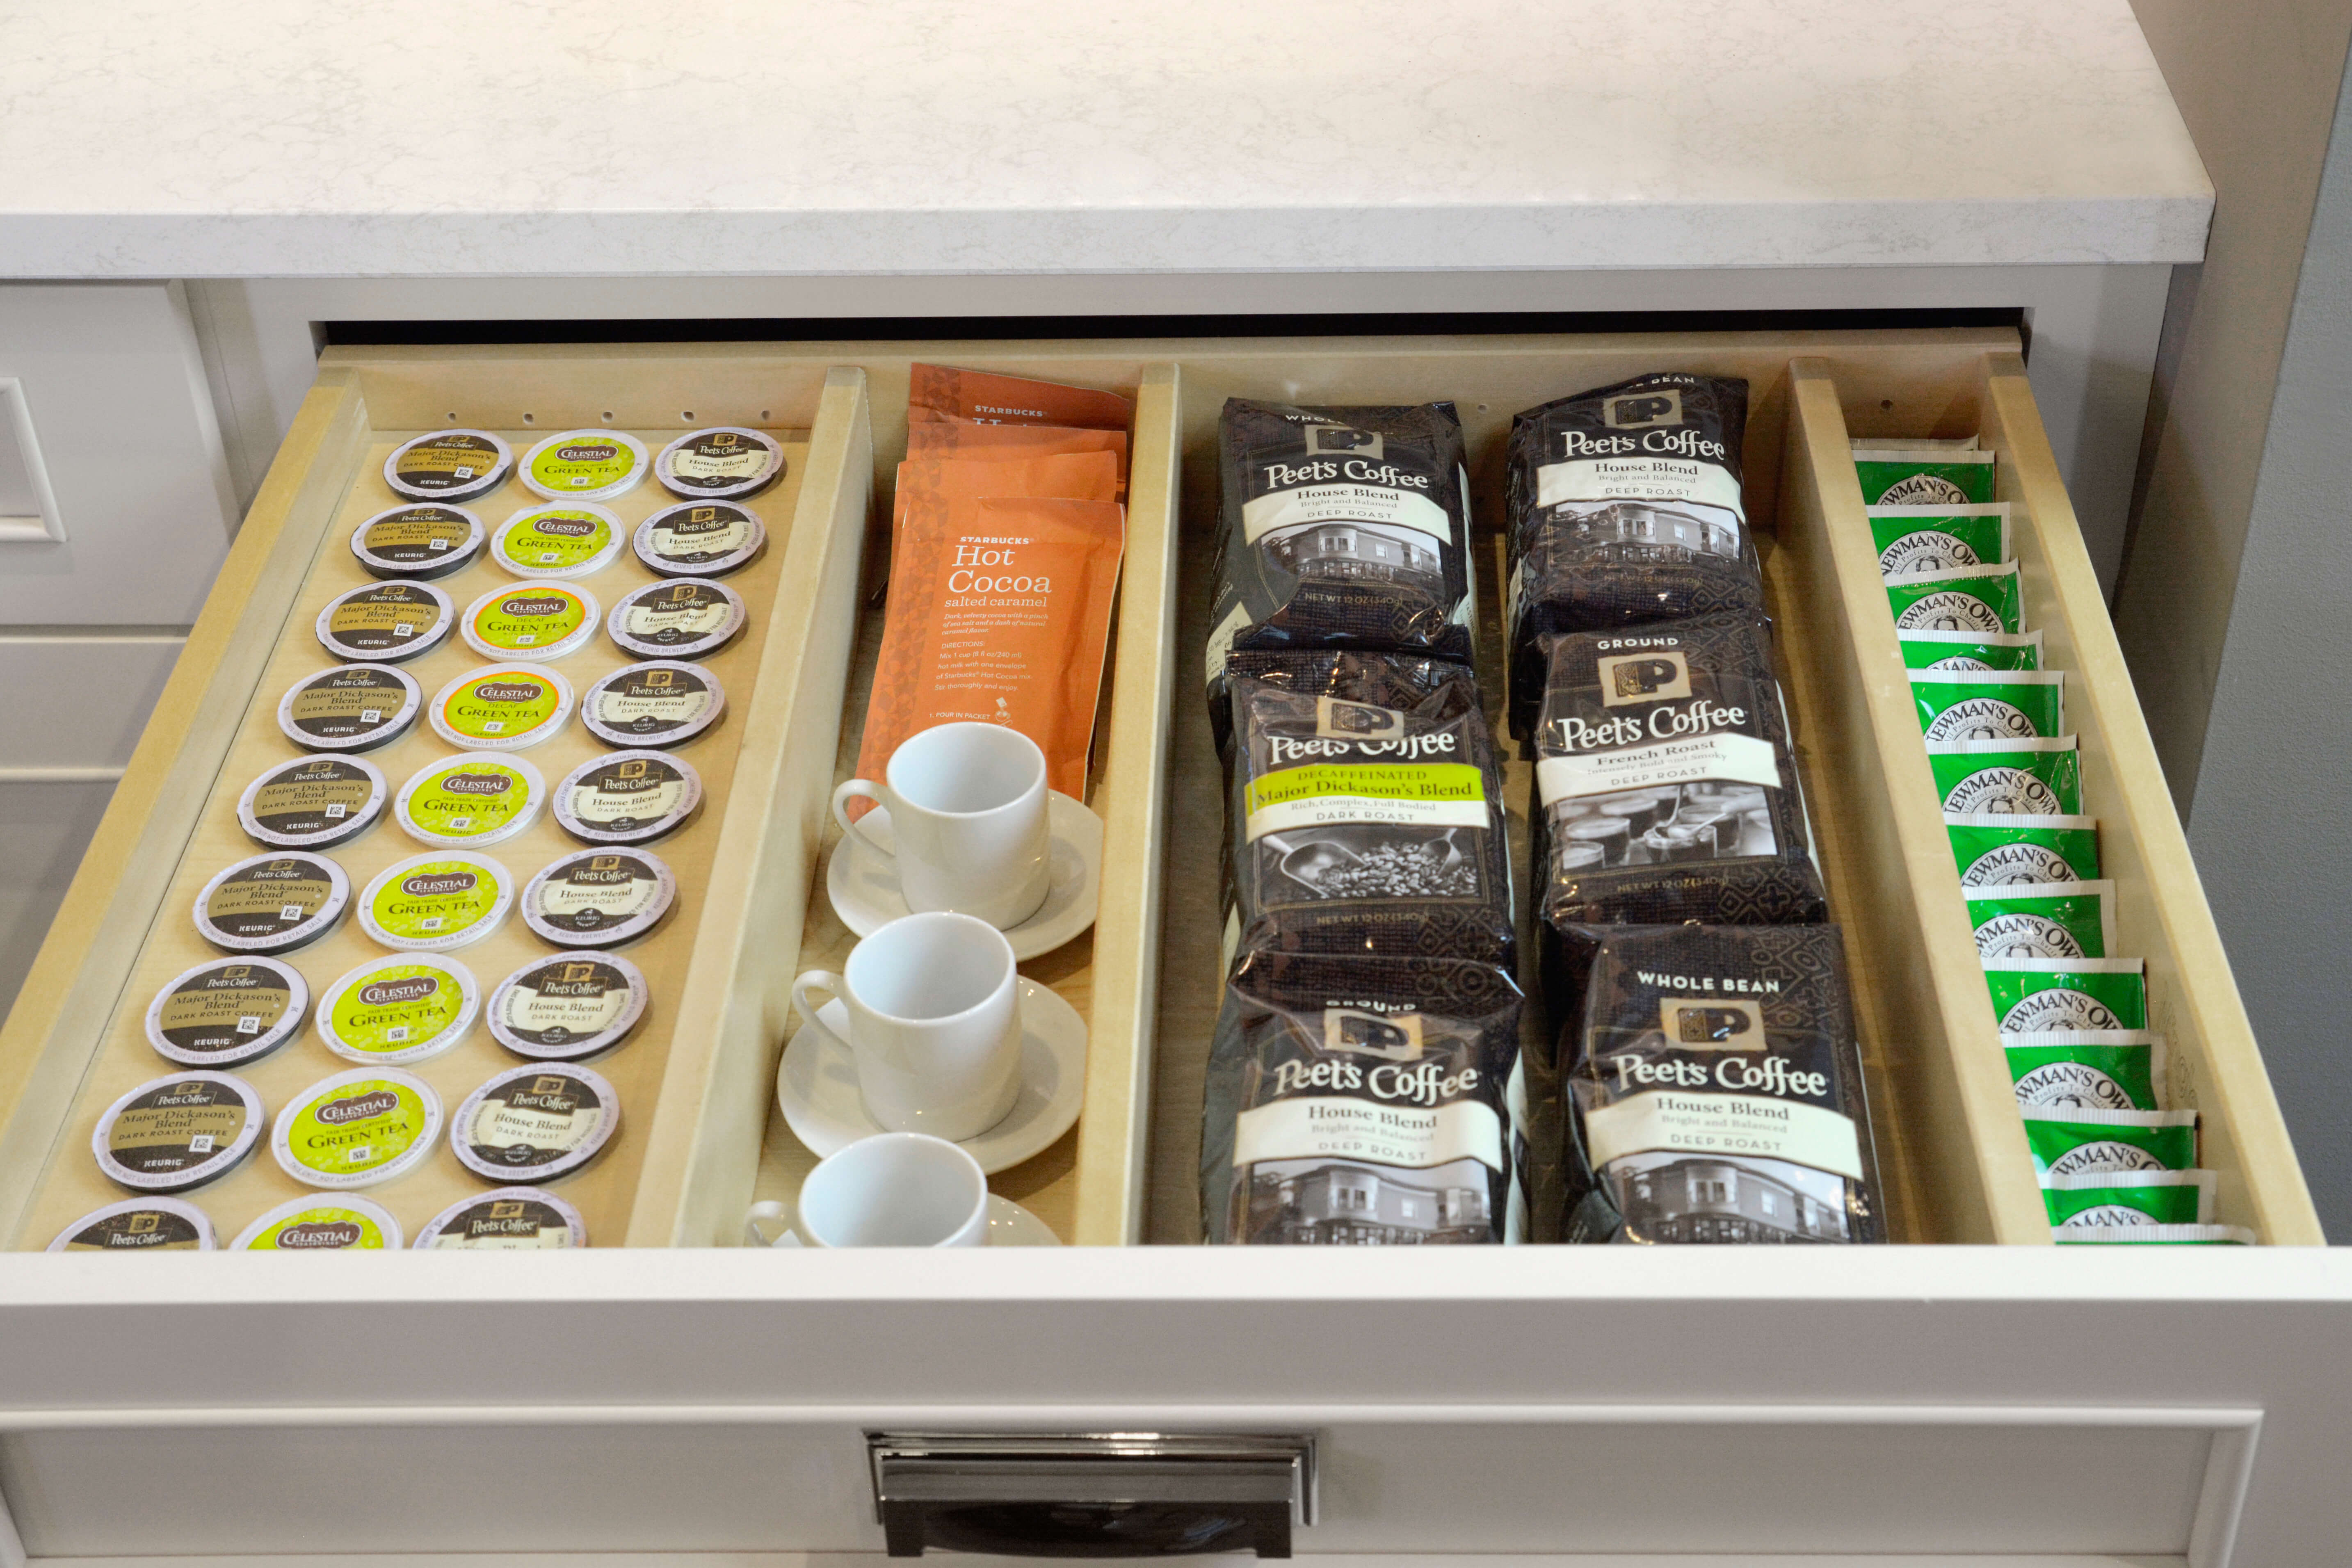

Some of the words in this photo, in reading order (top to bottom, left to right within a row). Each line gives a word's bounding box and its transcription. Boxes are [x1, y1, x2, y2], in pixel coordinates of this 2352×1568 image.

[975, 405, 1043, 417] STARBUCKS
[1286, 415, 1345, 424] WHOL
[1642, 429, 1724, 460] Coffee
[561, 449, 612, 459] CELESTIAL
[544, 465, 598, 474] GREEN
[602, 465, 620, 473] TEA
[1344, 460, 1428, 488] Coffee
[1595, 463, 1646, 473] House
[1652, 463, 1699, 475] Blend
[1297, 488, 1348, 500] House
[1354, 488, 1400, 501] Blend
[1647, 488, 1690, 497] ROAST
[1301, 499, 1329, 508] Bright
[1355, 499, 1397, 508] Balanced
[1349, 510, 1392, 519] ROAST
[952, 545, 1015, 566] Hot
[948, 570, 1052, 593] Cocoa
[507, 602, 561, 611] CELESTIAL
[945, 596, 986, 607] salted
[990, 597, 1047, 607] caramel
[341, 605, 371, 614] Major
[374, 605, 431, 614] Dickason's
[1898, 595, 1968, 630] EWMAN'S
[1918, 609, 1944, 624] Profits
[487, 621, 539, 631] GREEN
[396, 644, 417, 653] RETAIL
[417, 635, 431, 645] SALE
[1597, 637, 1678, 650] GROUND
[1648, 700, 1746, 738] Coffee
[1953, 719, 1980, 732] Profits
[1596, 749, 1658, 766] French
[1665, 739, 1717, 757] Roast
[1640, 759, 1664, 768] Bold
[1691, 751, 1728, 763] Smoky
[1297, 770, 1427, 781] DECAFFEINATED
[1611, 773, 1649, 786] DEEP
[1658, 767, 1706, 779] ROAST
[630, 778, 660, 789] Coffee
[265, 787, 298, 796] Major
[1257, 785, 1310, 805] Major
[1316, 781, 1414, 796] Dickason's
[1420, 782, 1472, 796] Blend
[1972, 787, 2000, 803] Profits
[592, 798, 629, 806] House
[632, 793, 662, 805] Blend
[1291, 801, 1316, 811] Rich,
[1319, 799, 1372, 808] Complex,
[1398, 802, 1436, 811] Bodied
[625, 803, 654, 812] ROAST
[1317, 812, 1356, 821] DARK
[1365, 812, 1415, 821] ROAST
[408, 879, 470, 891] CELESTIAL
[388, 903, 446, 914] GREEN
[452, 901, 480, 910] TEA
[1637, 972, 1715, 991] WHOLE
[1723, 979, 1780, 993] BEAN
[529, 1002, 566, 1011] House
[569, 1003, 604, 1012] Blend
[2000, 993, 2088, 1034] EWMAN'S
[1715, 1056, 1827, 1096] Coffee
[1368, 1063, 1478, 1105] Coffee
[322, 1098, 391, 1120] CELESTIAL
[1658, 1098, 1723, 1114] House
[1731, 1102, 1790, 1120] Blend
[1309, 1105, 1373, 1120] House
[1380, 1114, 1438, 1128] Blend
[307, 1129, 371, 1148] GREEN
[377, 1122, 409, 1135] TEA
[1671, 1134, 1715, 1145] DEEP
[1724, 1137, 1782, 1151] ROAST
[284, 1231, 352, 1244] CELESTIAL
